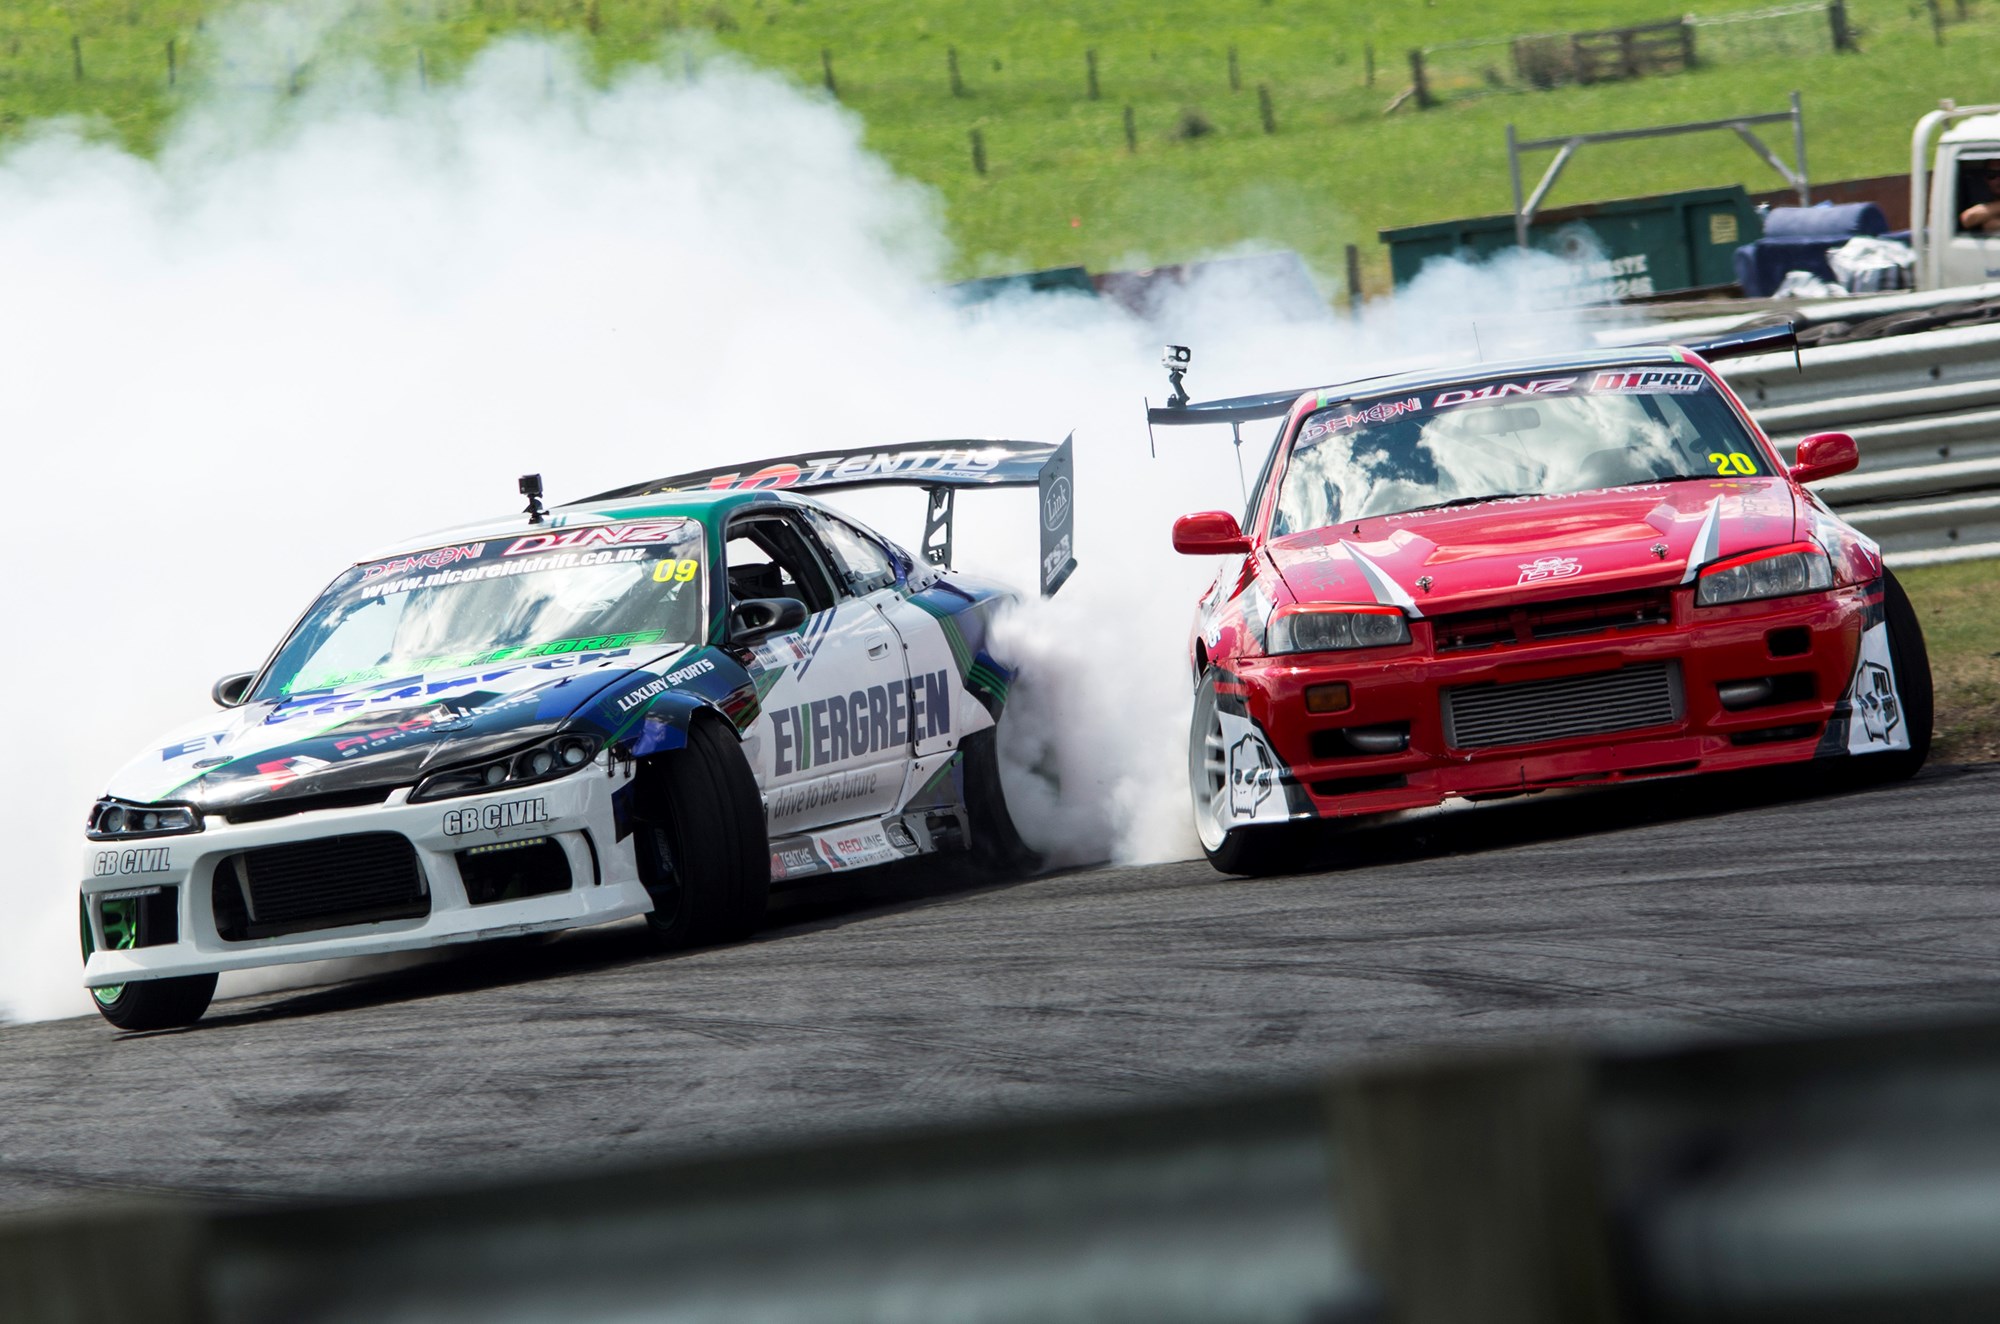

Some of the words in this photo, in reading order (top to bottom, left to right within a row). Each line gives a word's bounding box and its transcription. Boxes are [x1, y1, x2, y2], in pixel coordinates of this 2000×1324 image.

[1432, 377, 1578, 408] D1NZ
[805, 448, 1001, 483] TENTHS
[1708, 452, 1758, 476] 20
[1047, 484, 1068, 523] Link
[502, 521, 687, 557] D1NZ
[360, 547, 647, 599] www.nicoreiddrift.co.nz
[652, 558, 699, 583] 09
[617, 677, 669, 712] LUXURY
[665, 658, 715, 686] SPORTS
[768, 668, 951, 777] EVERGREEN
[774, 786, 805, 819] drive
[805, 785, 819, 810] to
[820, 775, 840, 806] the
[841, 772, 877, 801] future
[443, 808, 479, 836] GB
[483, 797, 548, 830] CIVIL
[93, 851, 119, 877] GB
[119, 847, 170, 875] CIVIL
[779, 847, 814, 867] TENTHS
[836, 833, 887, 856] REDLINE
